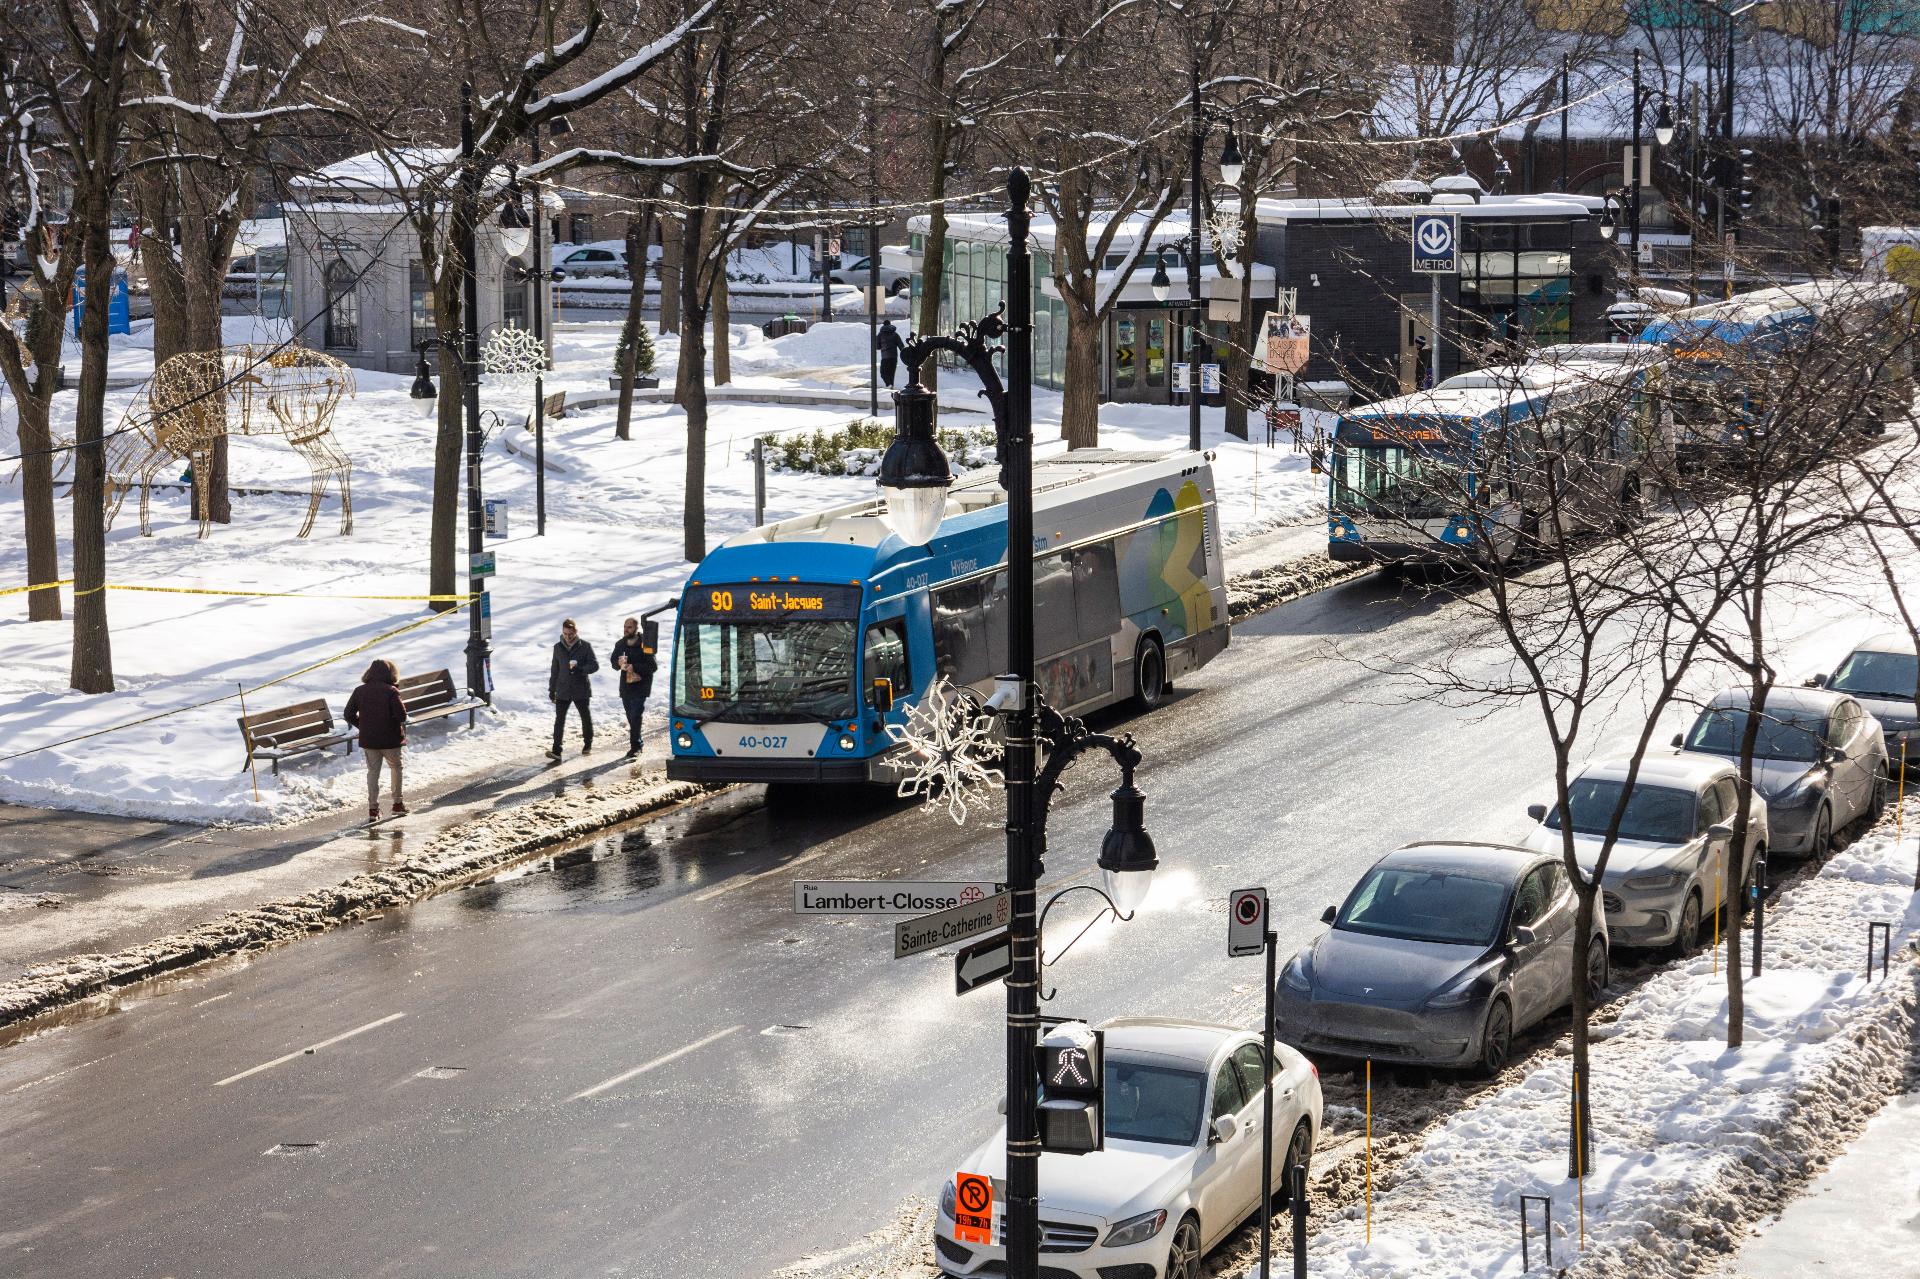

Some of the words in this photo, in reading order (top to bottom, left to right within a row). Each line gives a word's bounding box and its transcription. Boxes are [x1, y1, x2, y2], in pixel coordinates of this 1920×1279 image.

[1416, 259, 1453, 270] METRO
[906, 573, 929, 590] 40-027
[711, 591, 733, 611] 90
[750, 592, 823, 610] Saint-Jacques
[700, 687, 714, 699] 10
[739, 736, 788, 748] 40-027
[803, 892, 958, 910] Lambert-Closse
[901, 911, 993, 951] Sainte-Catherine
[958, 1214, 972, 1226] 19h
[979, 1216, 988, 1228] 7h
